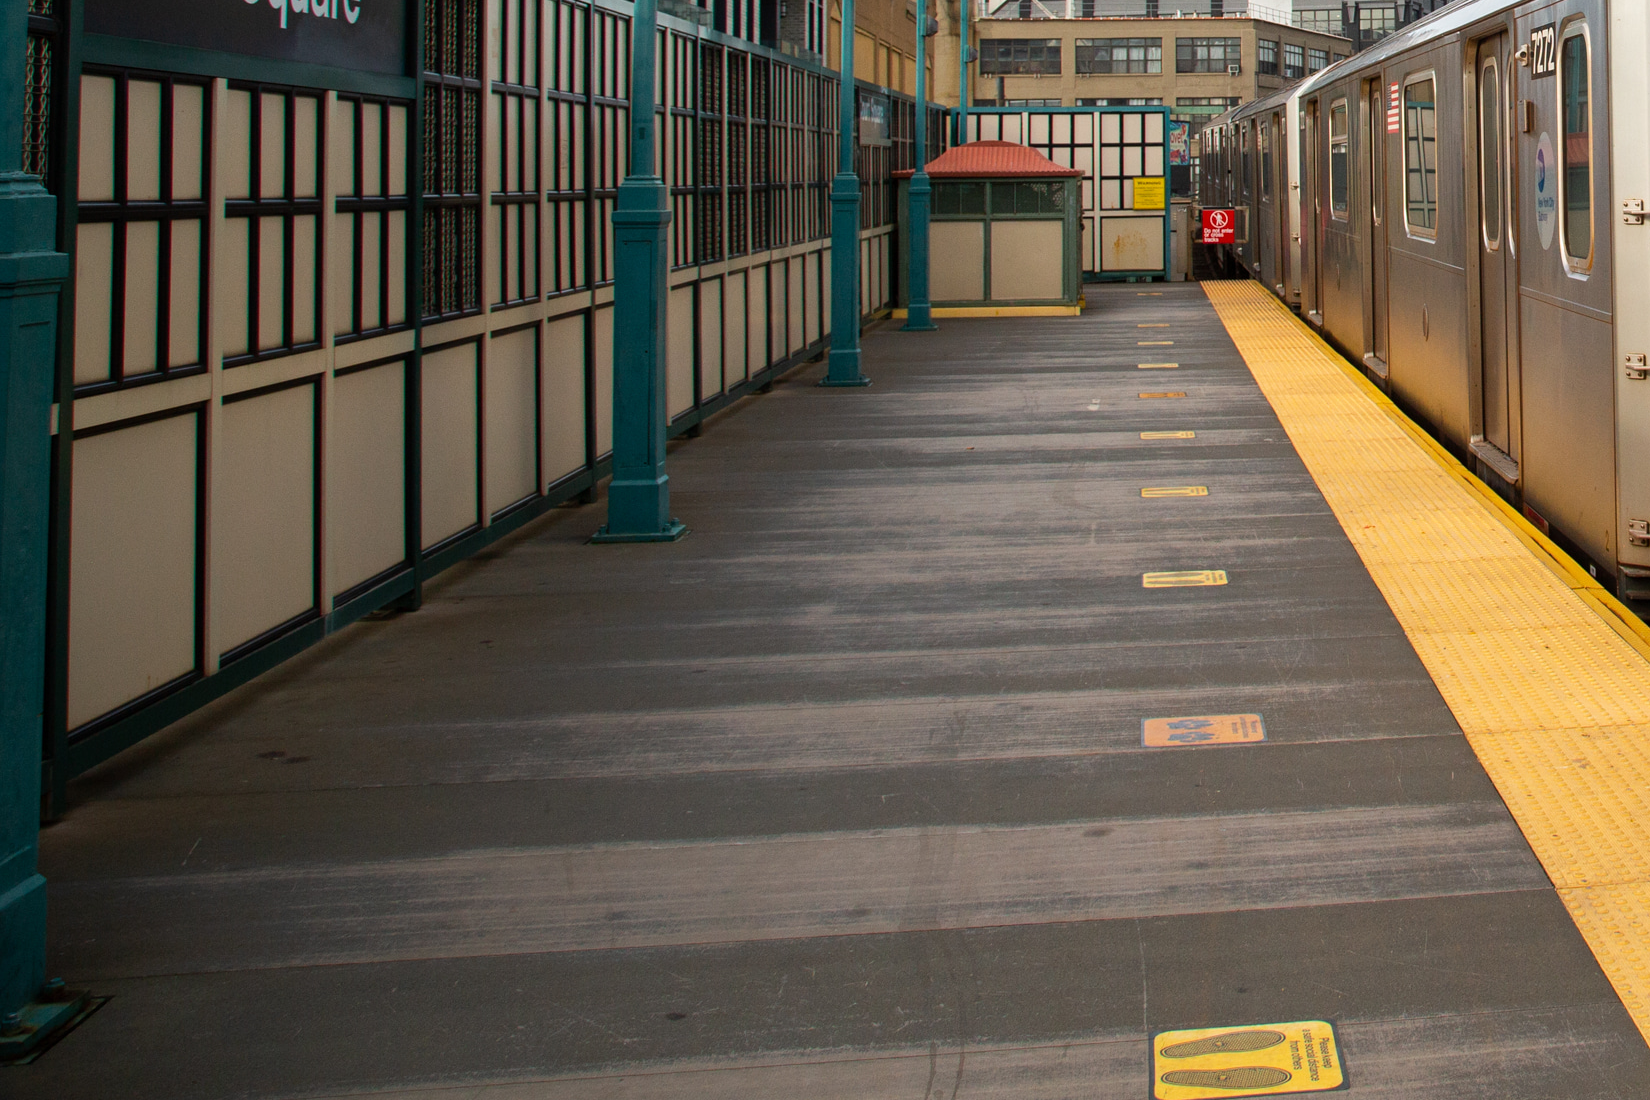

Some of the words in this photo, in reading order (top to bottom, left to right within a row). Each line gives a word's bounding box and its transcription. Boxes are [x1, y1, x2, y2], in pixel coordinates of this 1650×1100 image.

[1531, 27, 1555, 74] 7272
[1303, 1032, 1315, 1044] safe
[1319, 1037, 1330, 1054] Please
[1289, 1040, 1301, 1053] from
[1305, 1043, 1318, 1058] social
[1291, 1052, 1303, 1071] others
[1322, 1054, 1333, 1069] keep
[1308, 1058, 1320, 1082] distance
